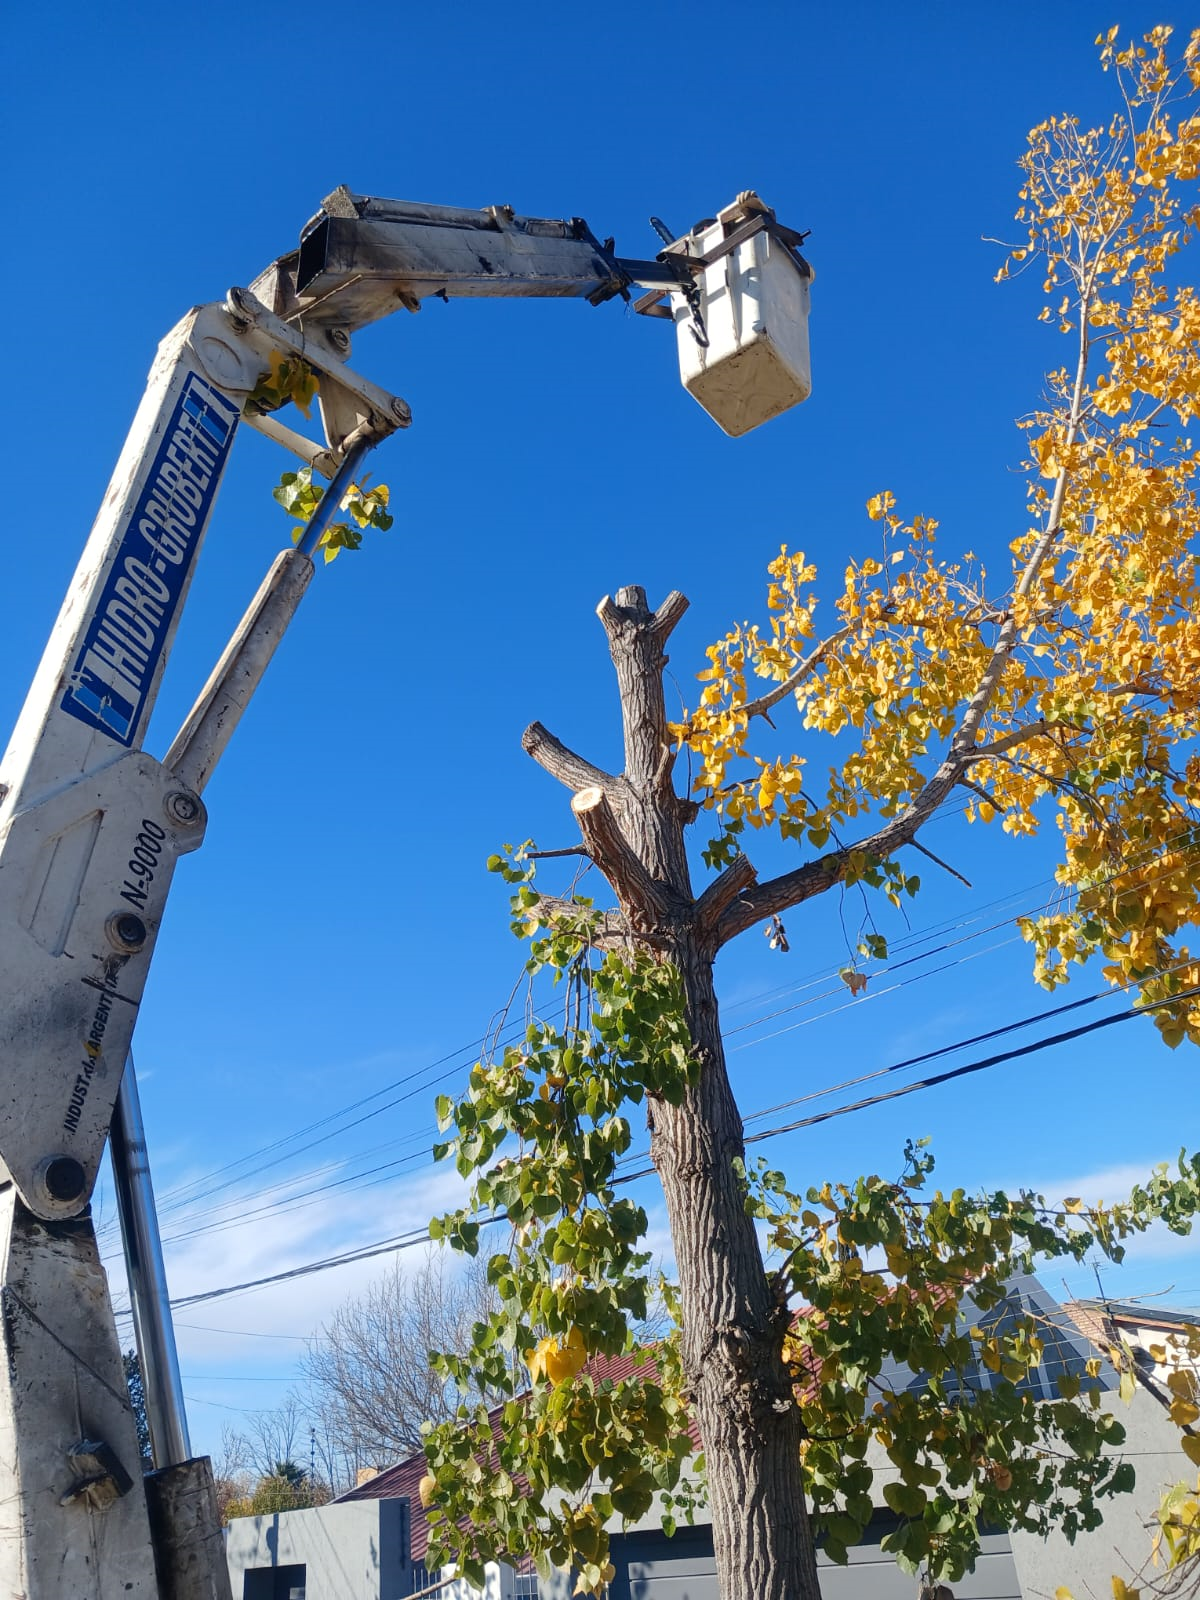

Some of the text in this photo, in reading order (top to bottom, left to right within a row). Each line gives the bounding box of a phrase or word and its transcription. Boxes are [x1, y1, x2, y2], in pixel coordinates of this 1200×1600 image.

[92, 411, 220, 685] HIDRO-GRUBERT
[120, 819, 166, 910] N-9000
[88, 972, 119, 1052] ARGENTA
